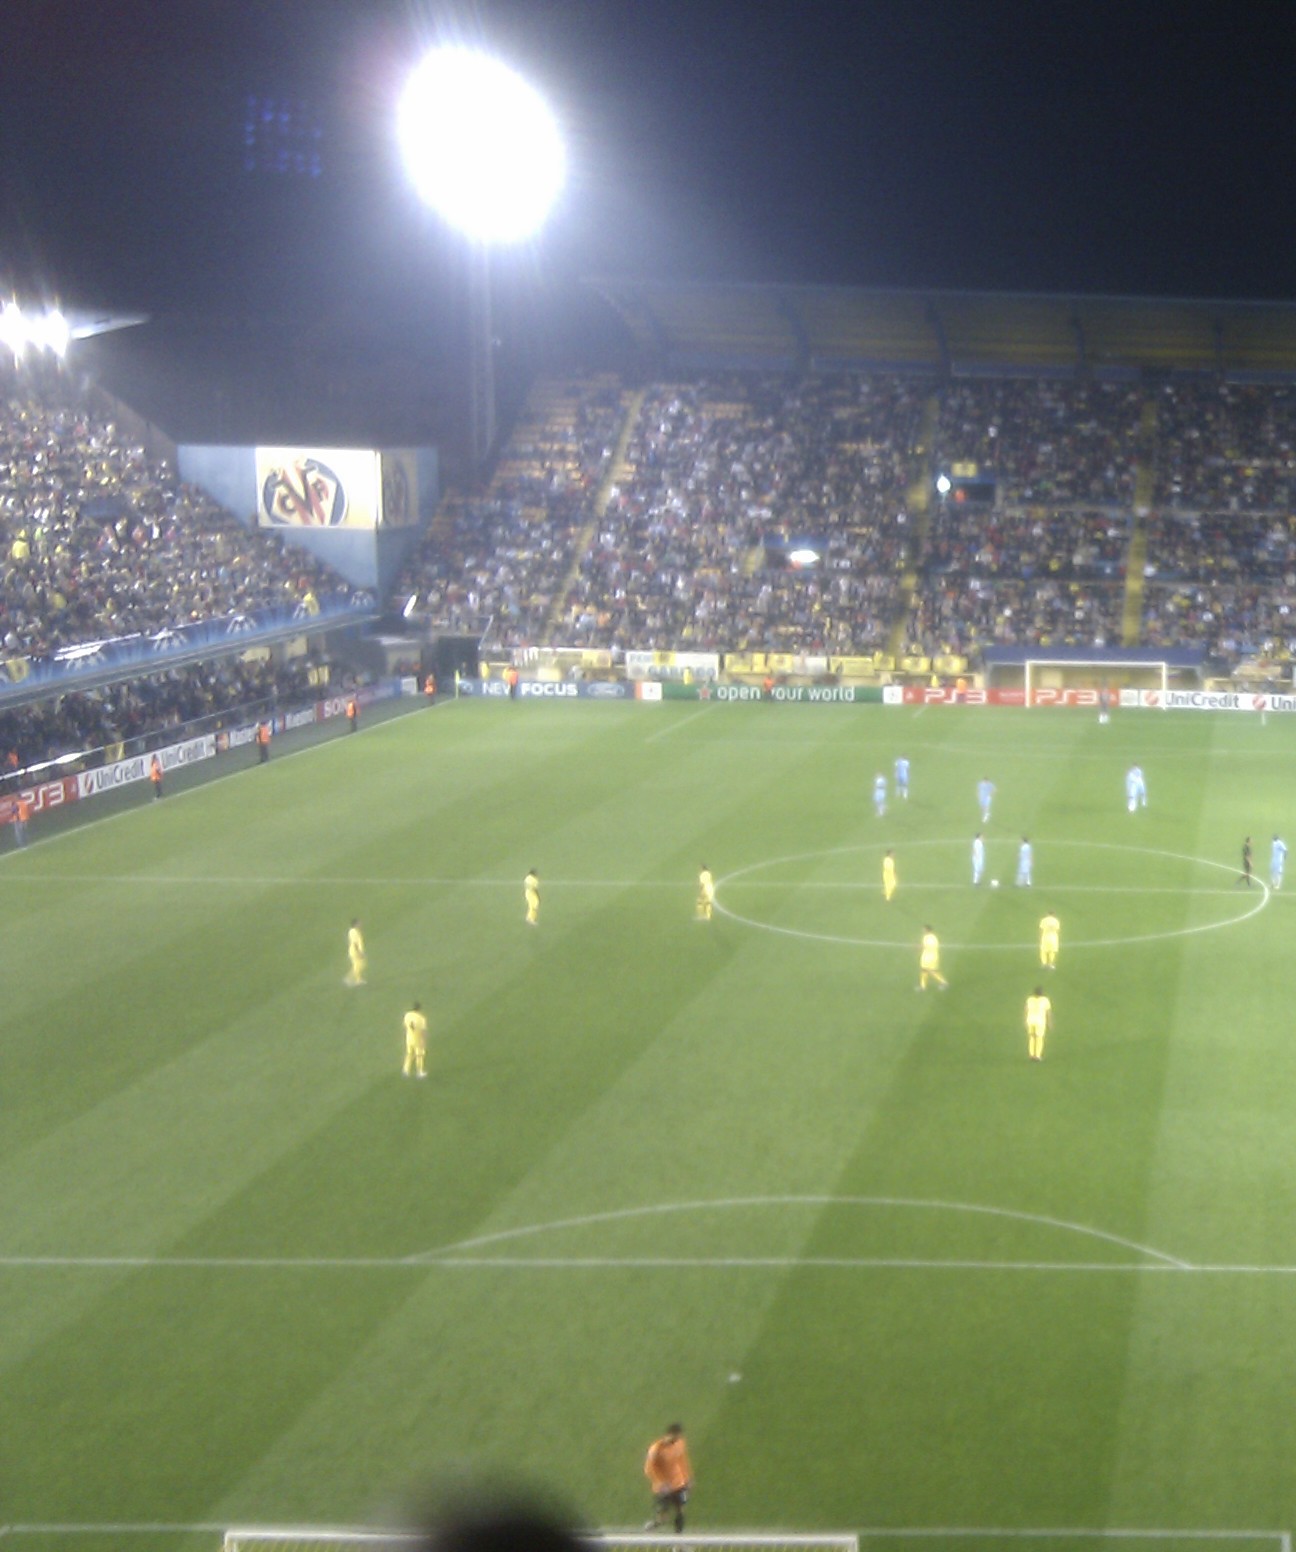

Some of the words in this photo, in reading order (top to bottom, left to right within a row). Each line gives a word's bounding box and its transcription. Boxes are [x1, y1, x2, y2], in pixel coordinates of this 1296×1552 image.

[521, 683, 578, 696] FOCUS
[717, 686, 760, 702] open
[771, 686, 802, 701] our
[808, 686, 855, 701] world
[924, 688, 987, 704] PS3
[1036, 689, 1098, 706] PS3
[1166, 692, 1240, 709] UniCredit
[96, 760, 145, 788] UniCredit
[21, 782, 65, 811] PS3
